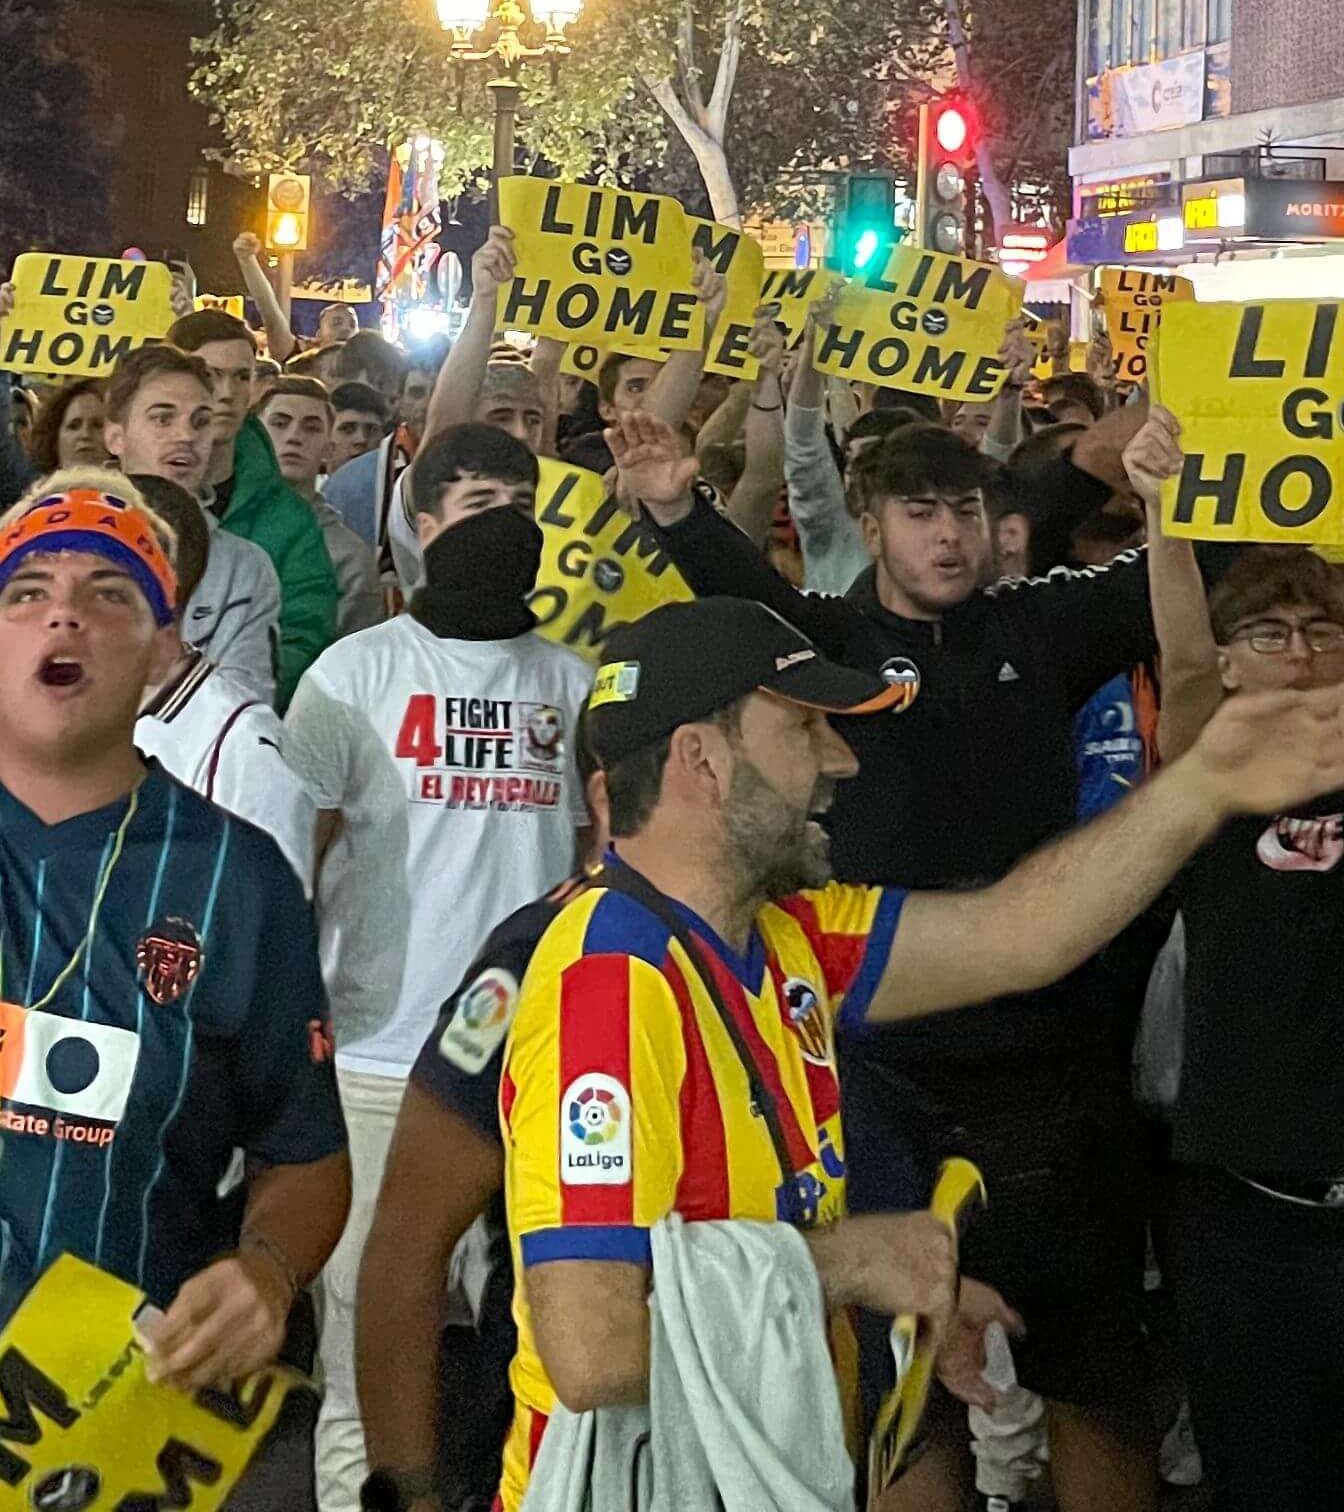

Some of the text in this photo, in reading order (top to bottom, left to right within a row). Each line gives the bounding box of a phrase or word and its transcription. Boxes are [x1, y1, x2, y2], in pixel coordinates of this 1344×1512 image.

[541, 185, 660, 244] LIM
[572, 242, 633, 276] GO
[39, 258, 147, 301] LIM
[864, 244, 992, 310] LIM
[1118, 271, 1176, 293] LIM
[63, 301, 115, 326] GO
[503, 277, 698, 338] HOME
[889, 300, 949, 335] GO
[1119, 312, 1161, 334] LI
[817, 324, 1008, 395] HOME
[558, 541, 625, 595] GO
[445, 697, 513, 729] FIGHT
[395, 694, 442, 767] 4
[445, 735, 513, 769] LIFE
[420, 775, 445, 800] EL
[54, 1117, 115, 1148] Group
[568, 1150, 625, 1170] LaLiga
